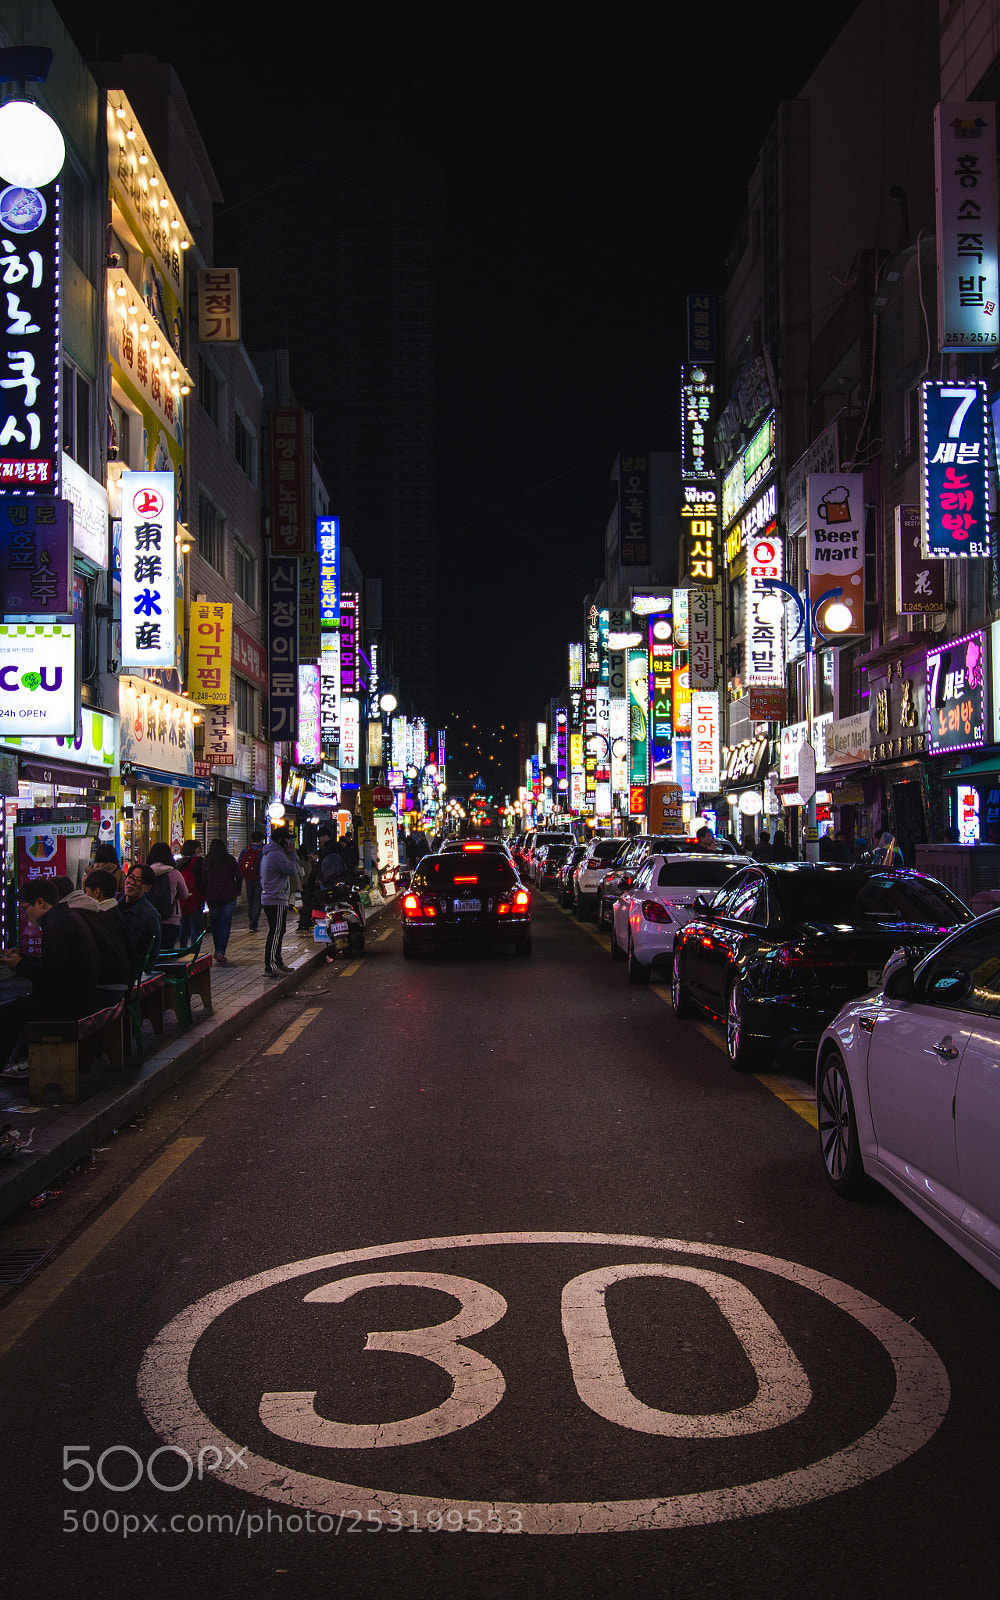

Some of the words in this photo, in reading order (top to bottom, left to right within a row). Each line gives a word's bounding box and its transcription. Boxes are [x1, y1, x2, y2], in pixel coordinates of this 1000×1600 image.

[955, 155, 986, 307] 홍소족발
[205, 273, 231, 338] 보청기
[0, 239, 42, 450] 히노쿠시
[939, 388, 977, 438] 7
[931, 443, 979, 464] 세븐
[8, 505, 56, 525] 멘토
[137, 492, 160, 512] 上
[681, 504, 717, 516] 스포츠
[685, 491, 716, 502] WHO
[939, 467, 978, 539] 노래방
[8, 530, 35, 569] 호프
[320, 521, 336, 564] 지평선
[691, 520, 714, 578] 마사지
[814, 528, 859, 543] Beer
[815, 546, 858, 562] Mart
[970, 541, 983, 552] B1
[40, 551, 50, 563] &
[754, 567, 774, 576] 本家
[30, 565, 57, 605] 소주
[133, 522, 163, 650] 東洋水産
[320, 565, 336, 608] 부동산
[198, 606, 224, 620] 골목
[299, 592, 315, 634] 갈매기
[693, 593, 712, 627] 장터
[197, 622, 224, 689] 아구찜
[271, 567, 296, 733] 신창의료기
[340, 616, 354, 685] 미진모텔
[653, 660, 672, 672] 원조
[693, 631, 713, 678] 보신탕
[191, 692, 227, 701] T.248-0203
[321, 674, 338, 723] 주전자
[927, 653, 941, 708] 7
[943, 669, 965, 701] 세븐
[0, 710, 16, 718] 24h
[19, 710, 47, 718] OPEN
[209, 705, 230, 753] 감나무집
[939, 700, 974, 736] 노래방
[974, 726, 981, 739] B1
[344, 717, 355, 765] 한신포차
[698, 706, 716, 774] 도야족발
[384, 826, 395, 849] 서래
[259, 1263, 812, 1448] 30
